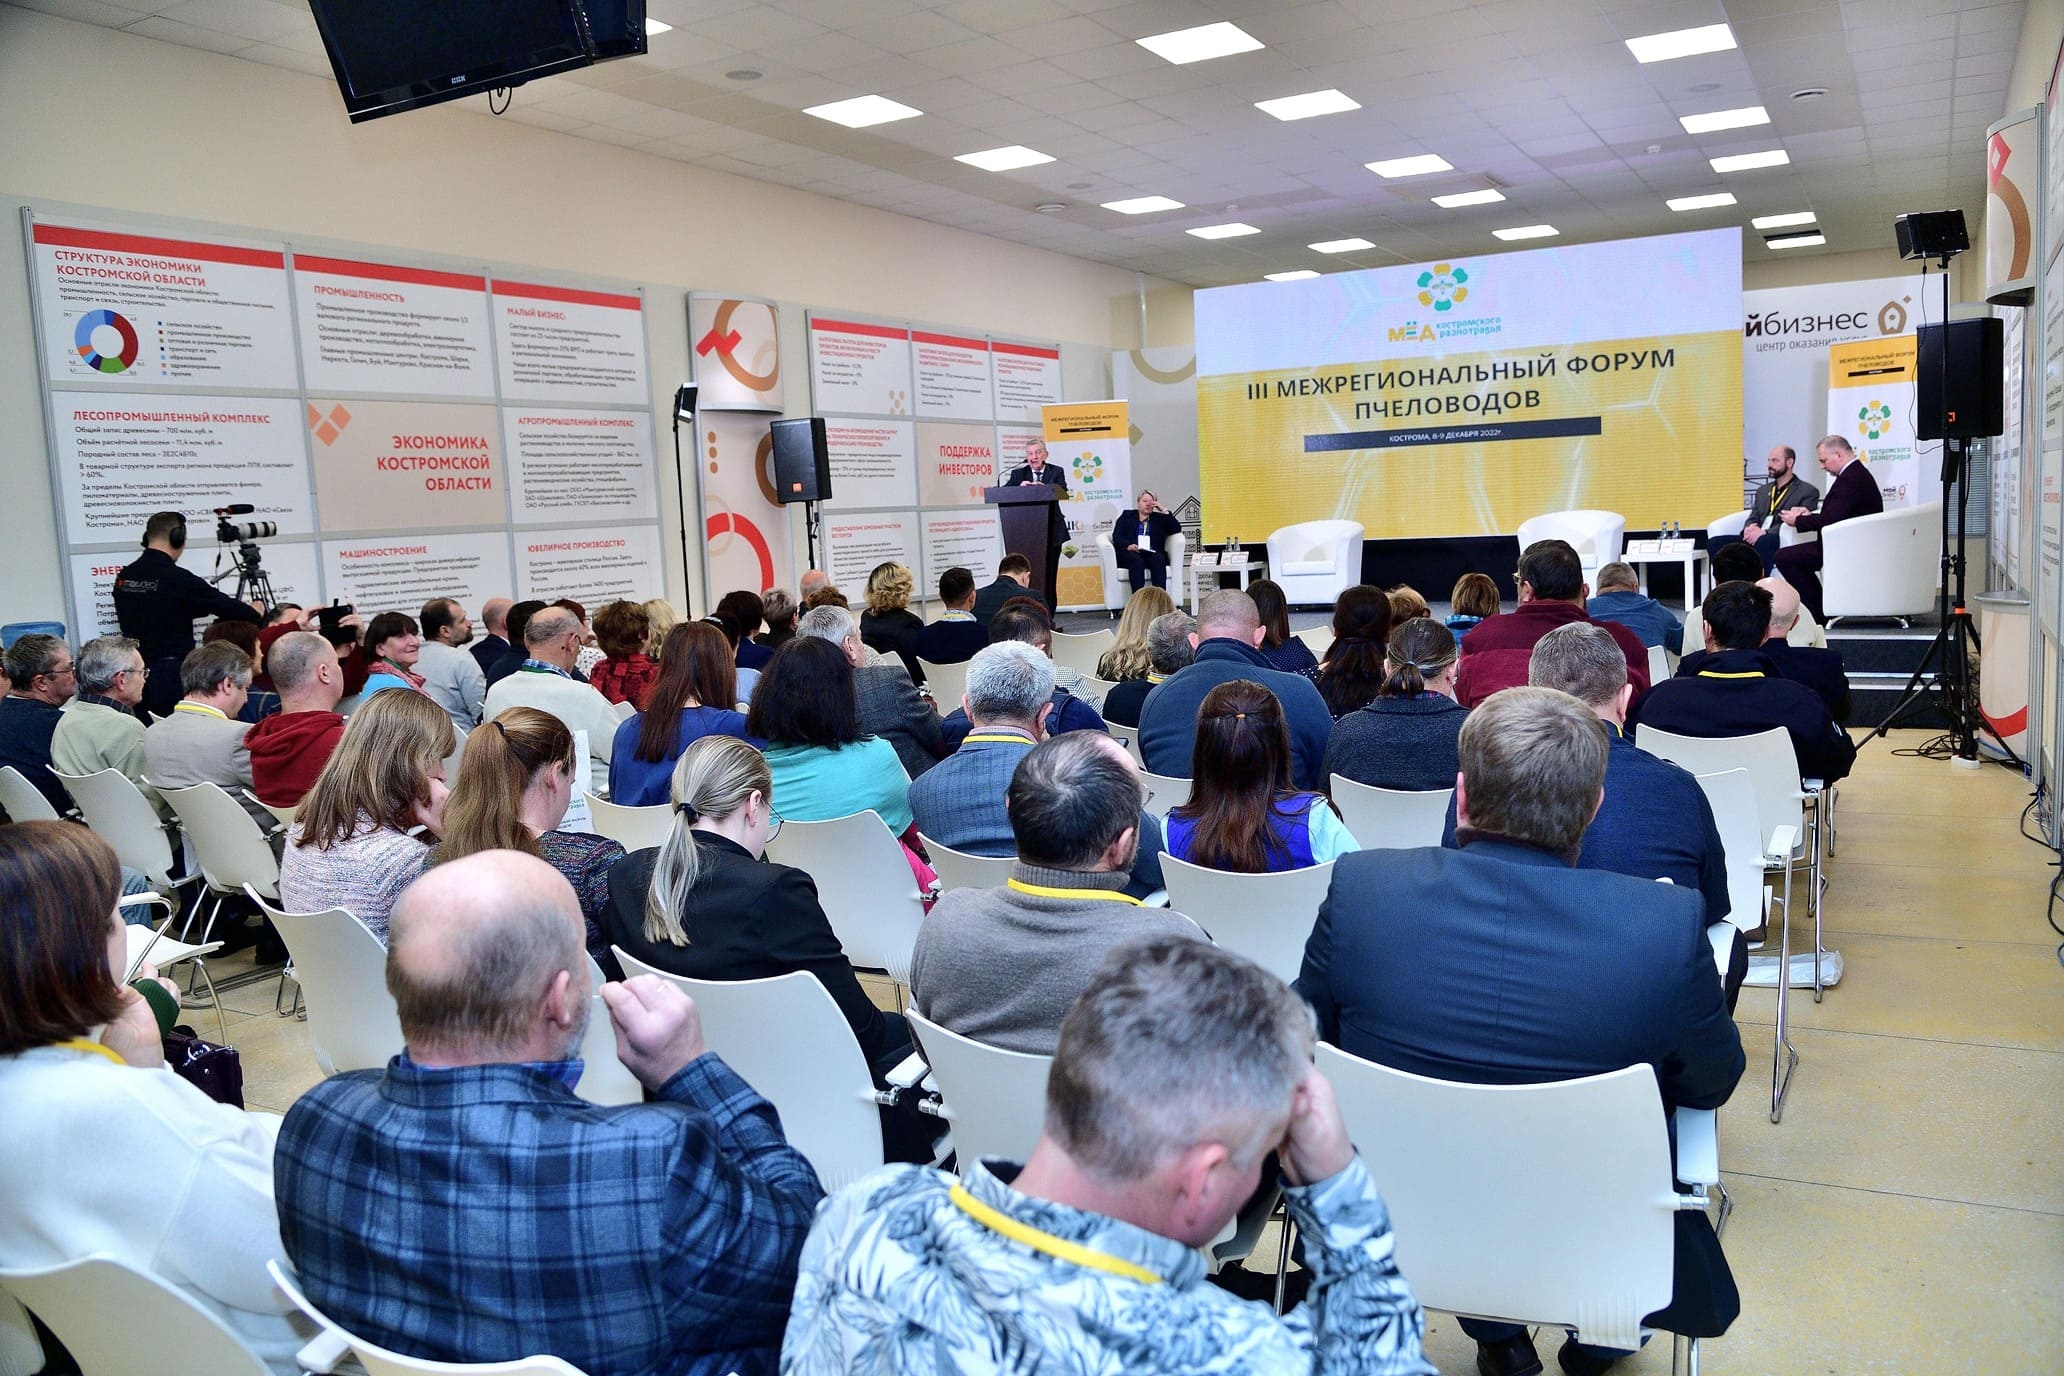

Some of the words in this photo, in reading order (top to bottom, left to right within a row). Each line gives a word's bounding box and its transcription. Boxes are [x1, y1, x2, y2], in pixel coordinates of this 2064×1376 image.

[55, 251, 124, 266] СТРУКТУРА
[127, 258, 201, 273] ЭКОНОМИКИ
[57, 265, 150, 281] КОСТРОМСКОЙ
[154, 274, 206, 287] ОБЛАСТИ
[314, 285, 405, 303] ПРОМЫШЛЕННОСТЬ
[507, 307, 536, 317] МАЛЫЙ
[1436, 317, 1501, 329] костромского
[1388, 321, 1435, 342] МЁД
[1440, 326, 1502, 338] разнотравья
[1756, 341, 1786, 353] центр
[1840, 352, 1895, 364] МЕЖРЕГИОНАЛЬНЫЙ
[1896, 350, 1915, 358] ФОРУМ
[1858, 360, 1895, 368] ПЧЕЛОВОДОВ
[1248, 383, 1268, 400] III
[1278, 353, 1556, 398] МЕЖРЕГИОНАЛЬНЫЙ
[1566, 348, 1675, 375] ФОРУМ
[1356, 390, 1541, 420] ПЧЕЛОВОДОВ
[73, 410, 210, 423] ЛЕСОПРОМЫШЛЕННЫЙ
[212, 414, 271, 424] КОМПЛЕКС
[518, 417, 598, 427] АГРОПРОМЫШЛЕННЫЙ
[600, 419, 635, 428] КОМПЛЕКС
[75, 426, 101, 434] Общий
[1389, 433, 1431, 442] КОСТРОМА,
[1446, 430, 1479, 440] ДЕКАБРЯ
[392, 435, 488, 449] ЭКОНОМИКА
[78, 451, 115, 459] Породный
[940, 445, 991, 458] ПОДДЕРЖКА
[377, 454, 490, 470] КОСТРОМСКОЙ
[939, 464, 993, 475] ИНВЕСТОРОВ
[426, 477, 492, 491] ОБЛАСТИ
[340, 546, 428, 559] МАШИНОСТРОЕНИЕ
[528, 543, 572, 553] ЮВЕЛИРНОЕ
[573, 540, 626, 549] ПРОИЗВОДСТВО
